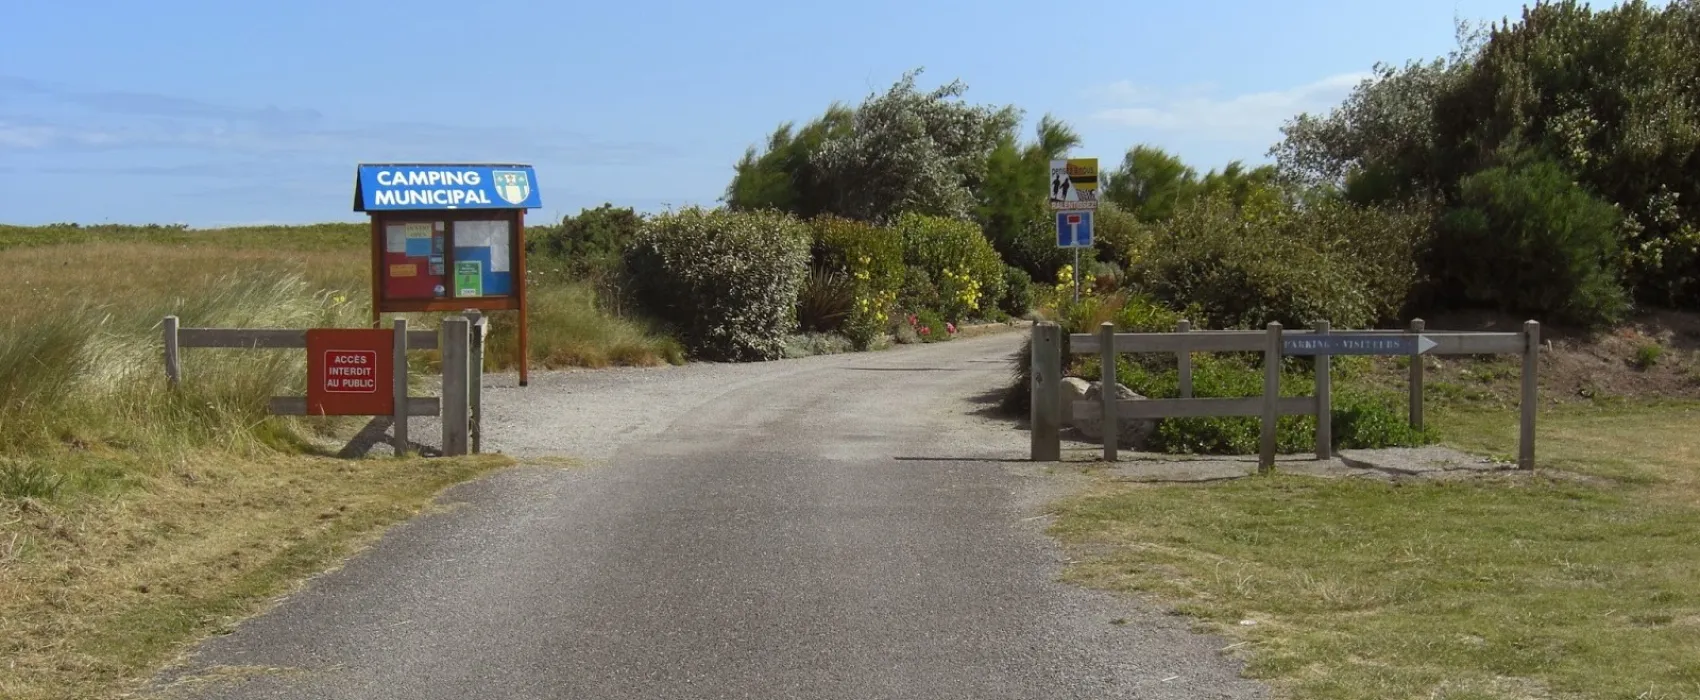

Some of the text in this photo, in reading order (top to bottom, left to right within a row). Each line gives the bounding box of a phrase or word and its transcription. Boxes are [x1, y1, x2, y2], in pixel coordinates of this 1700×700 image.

[377, 171, 481, 186] CAMPING
[375, 189, 491, 205] MUNICIPAL
[329, 367, 371, 376] INTERDIT
[327, 379, 374, 387] AU PUBLIC
